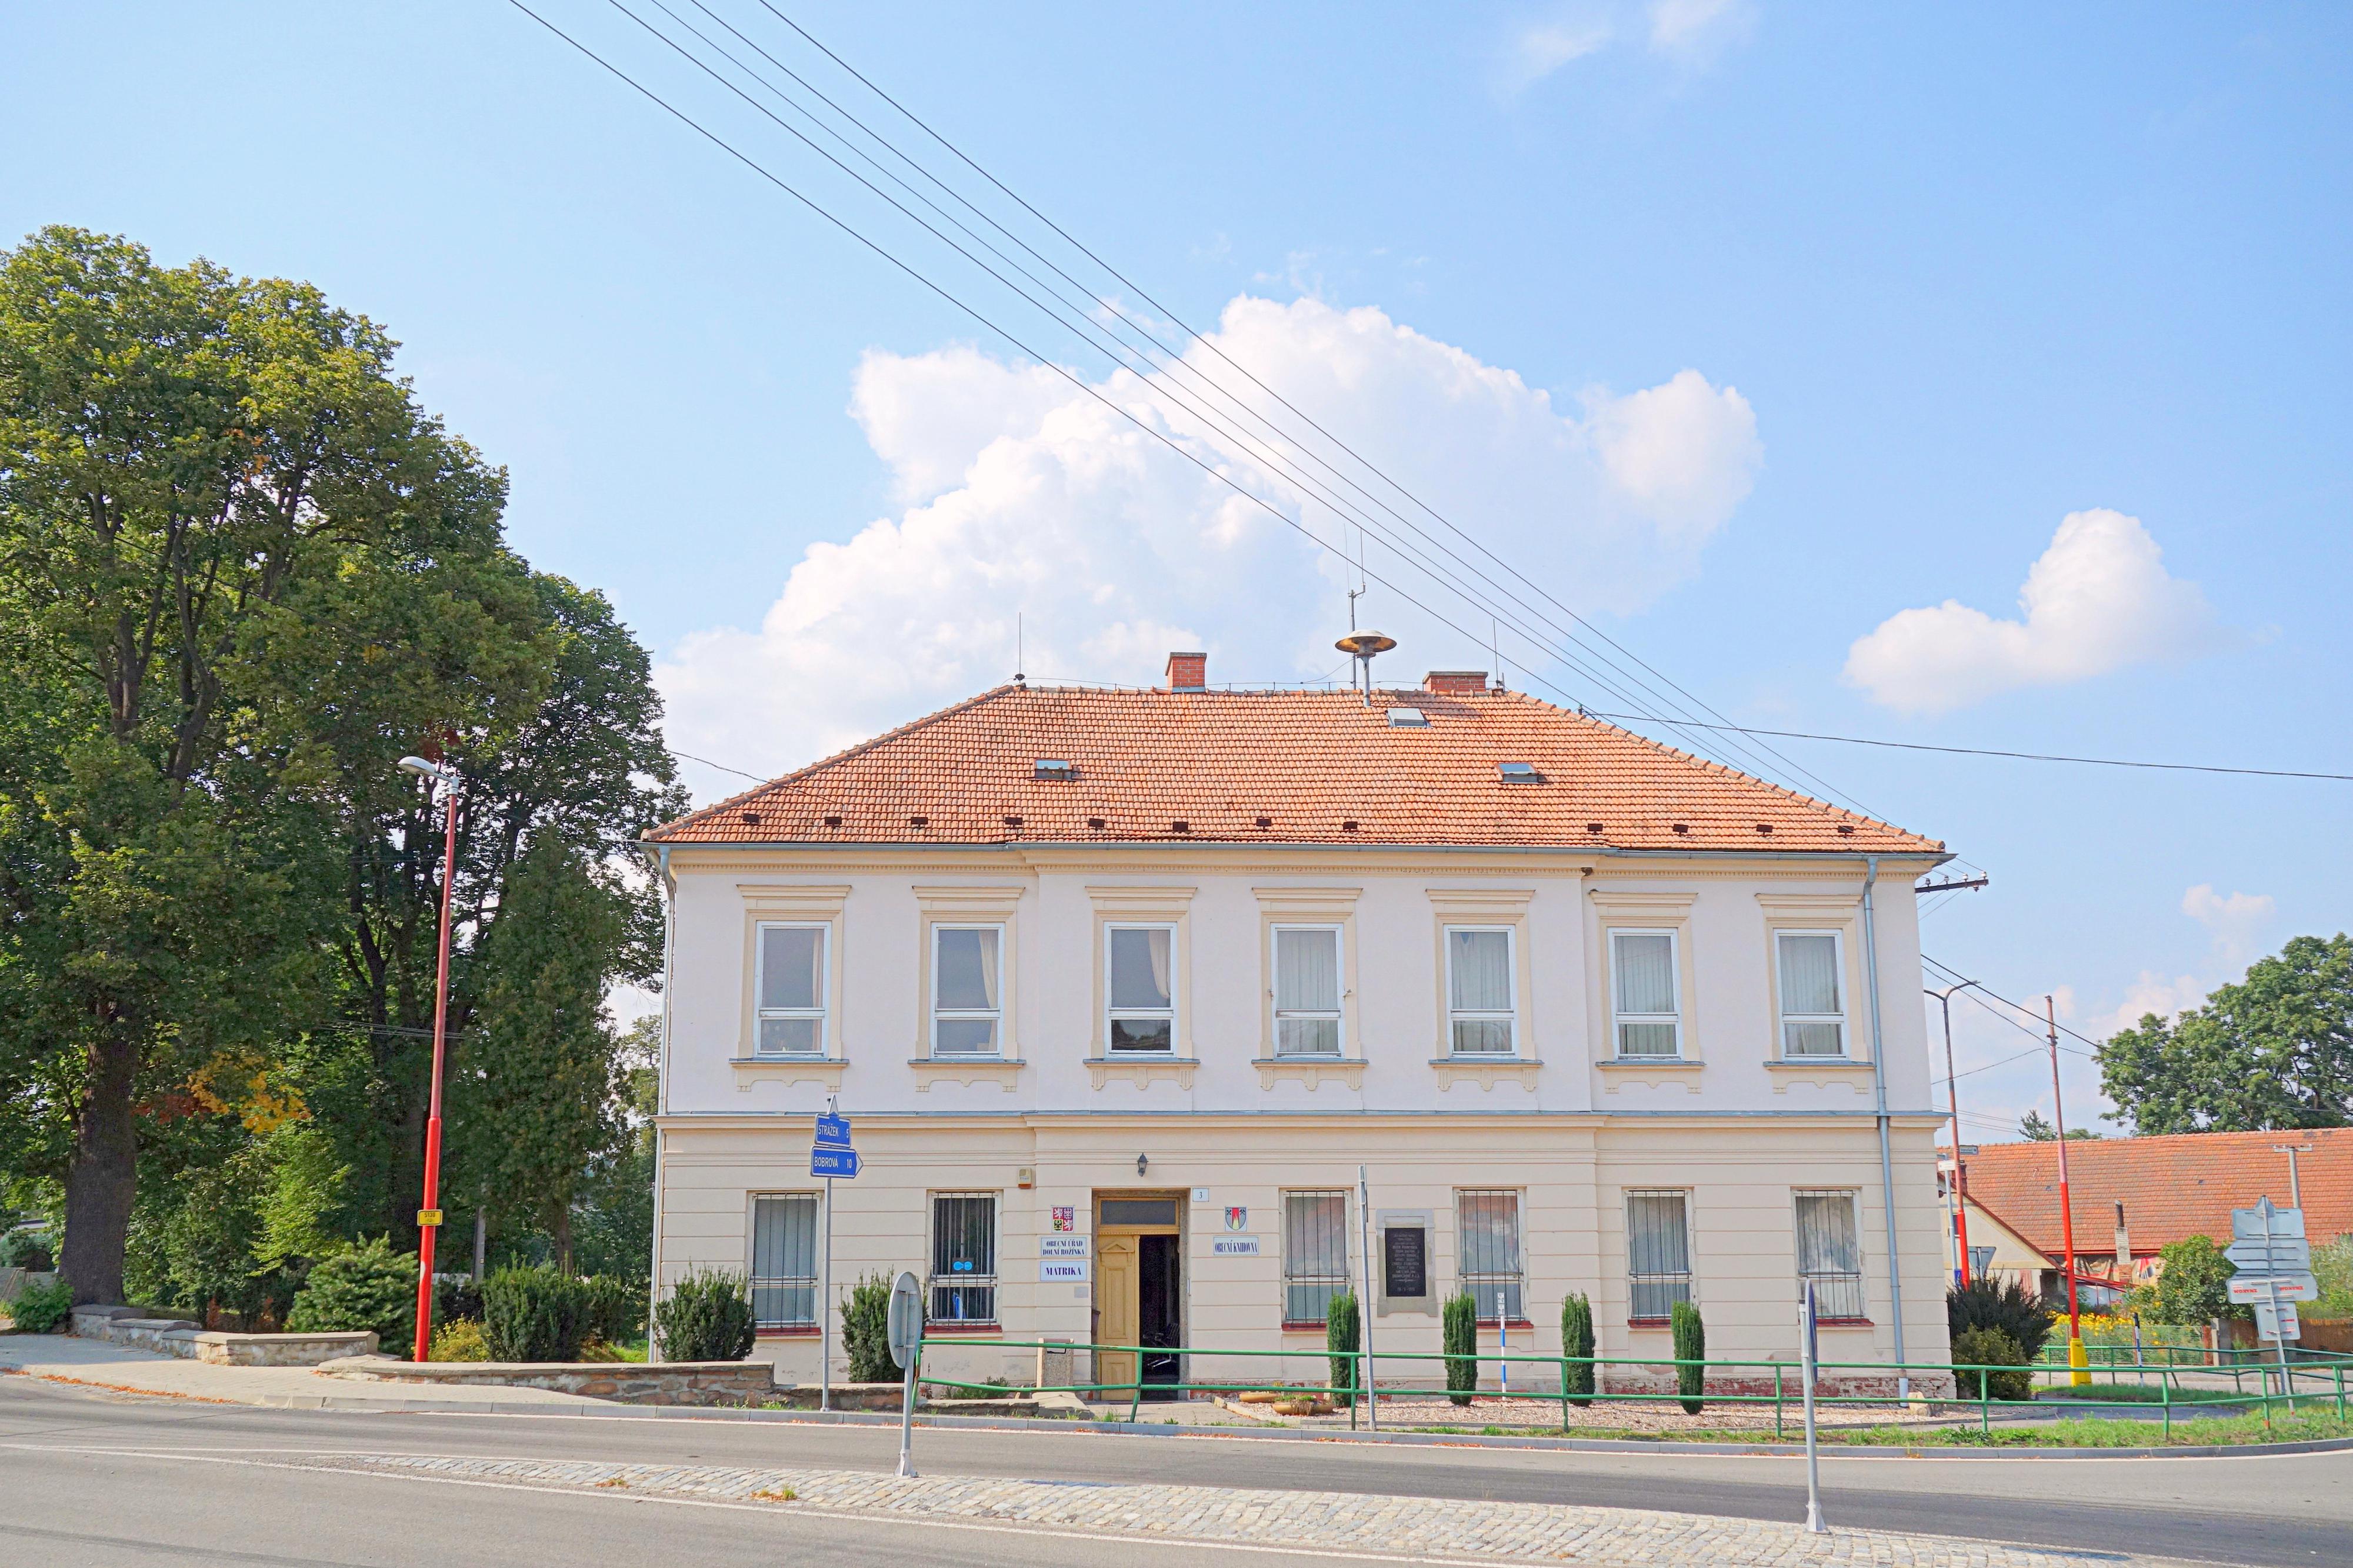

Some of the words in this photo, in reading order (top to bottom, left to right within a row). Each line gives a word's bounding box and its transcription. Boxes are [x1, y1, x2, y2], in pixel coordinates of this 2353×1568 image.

[818, 1123, 839, 1137] STRÁŽEK
[846, 1128, 849, 1139] 5
[814, 1156, 838, 1168] BOBROVÁ
[846, 1159, 852, 1169] 10
[1046, 1239, 1066, 1247] OBECNÍ
[1068, 1239, 1083, 1247] ÚŘAD
[1215, 1239, 1232, 1253] OBECNÍ
[1234, 1242, 1258, 1253] KNIHOVNA
[1046, 1267, 1082, 1276] MATRIKA
